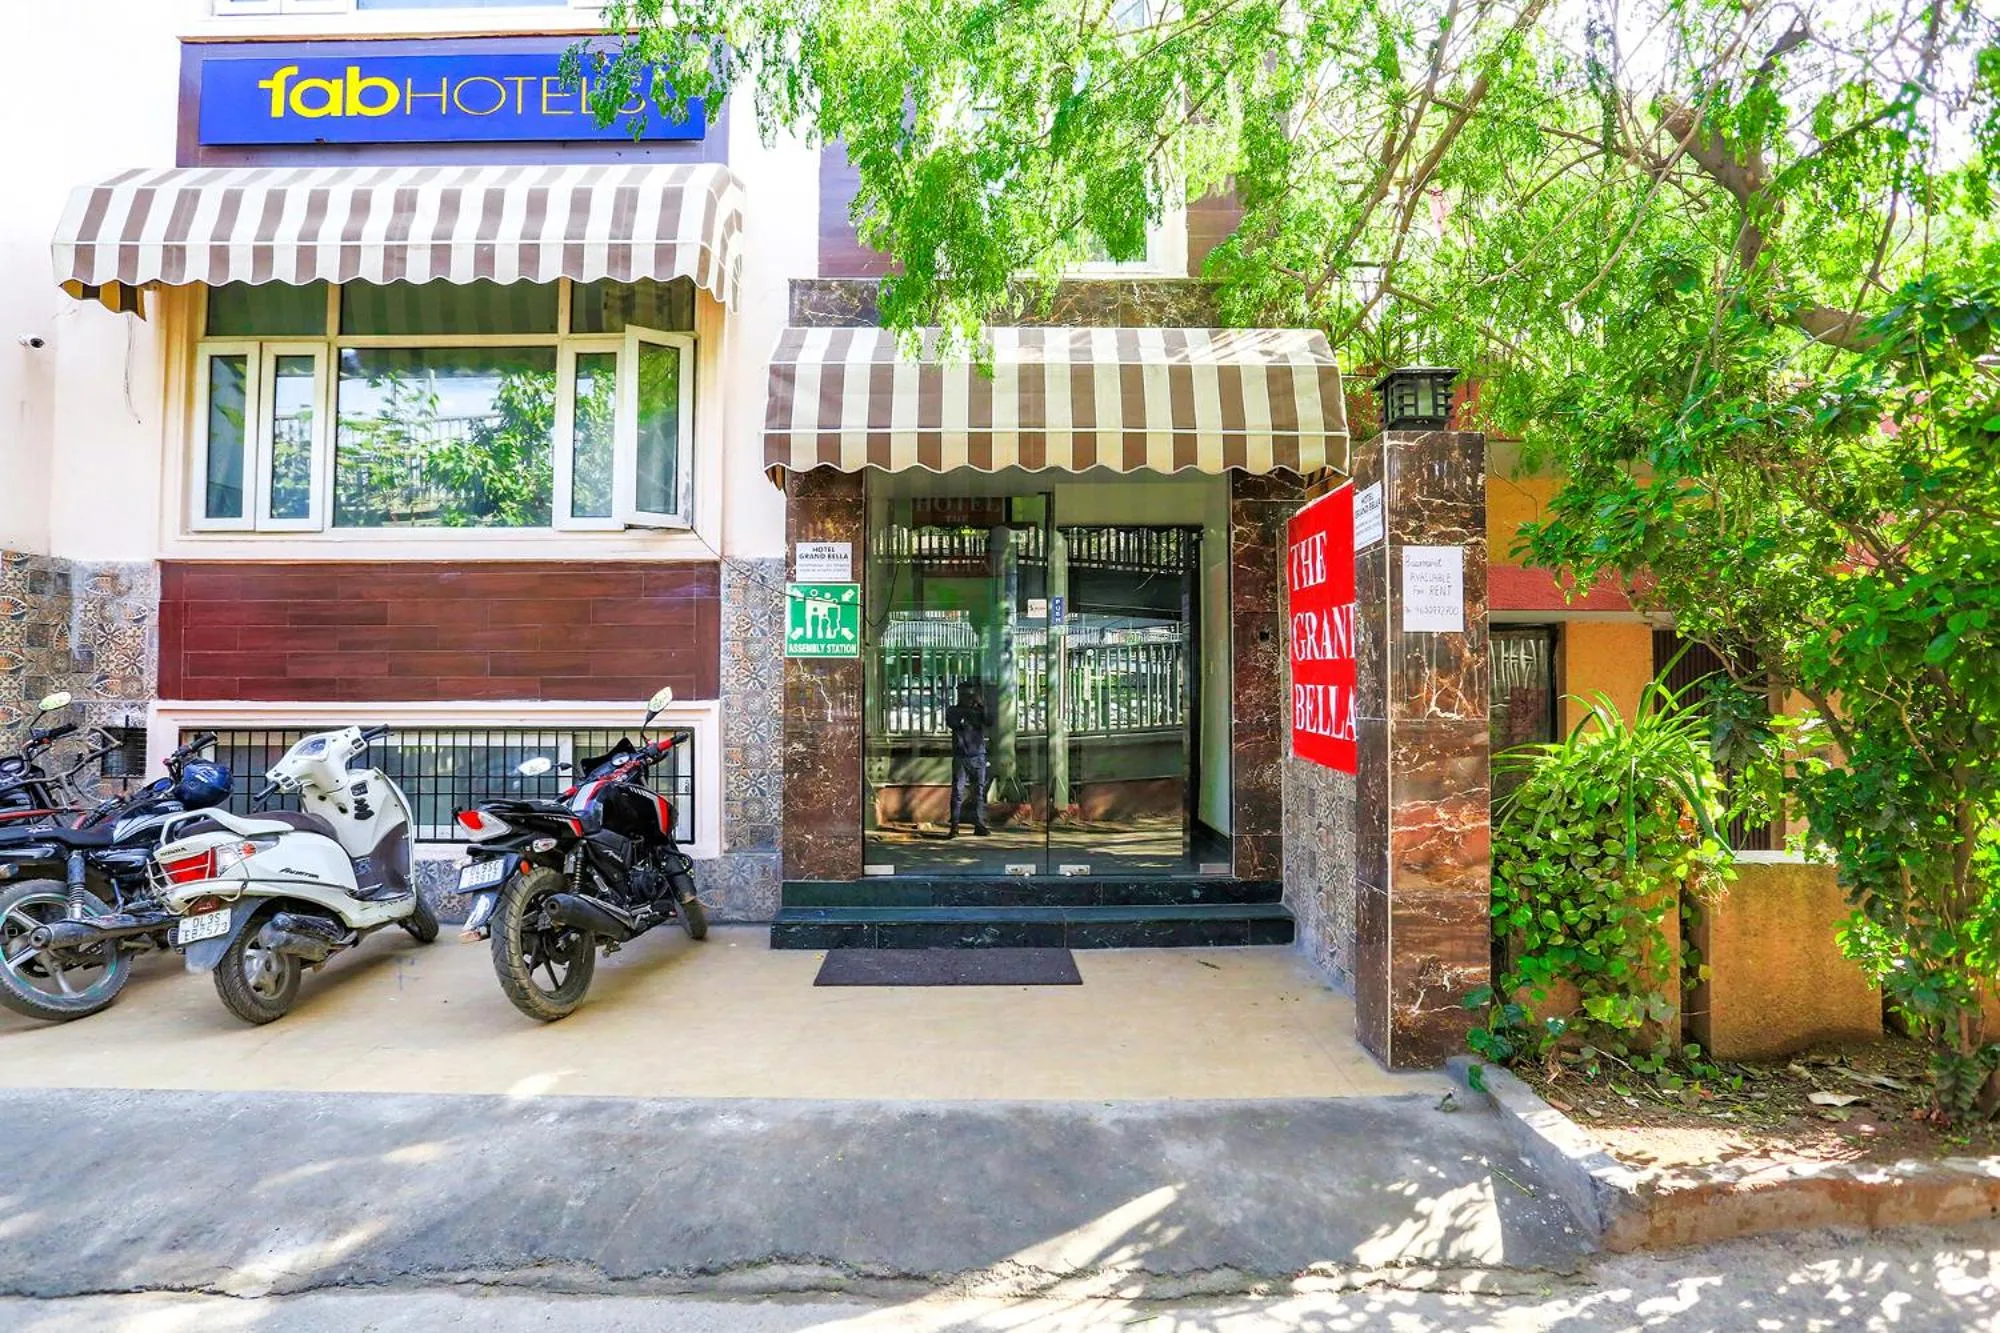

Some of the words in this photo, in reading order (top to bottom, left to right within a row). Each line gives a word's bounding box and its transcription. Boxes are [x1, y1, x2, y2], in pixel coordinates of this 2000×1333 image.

[798, 552, 826, 560] GRAND
[827, 552, 849, 560] BELLA
[1290, 531, 1328, 591] THE
[788, 643, 825, 654] ASSEMBLY
[826, 643, 857, 654] STATION
[1293, 603, 1356, 661] GRAN
[1295, 684, 1357, 741] BELLA
